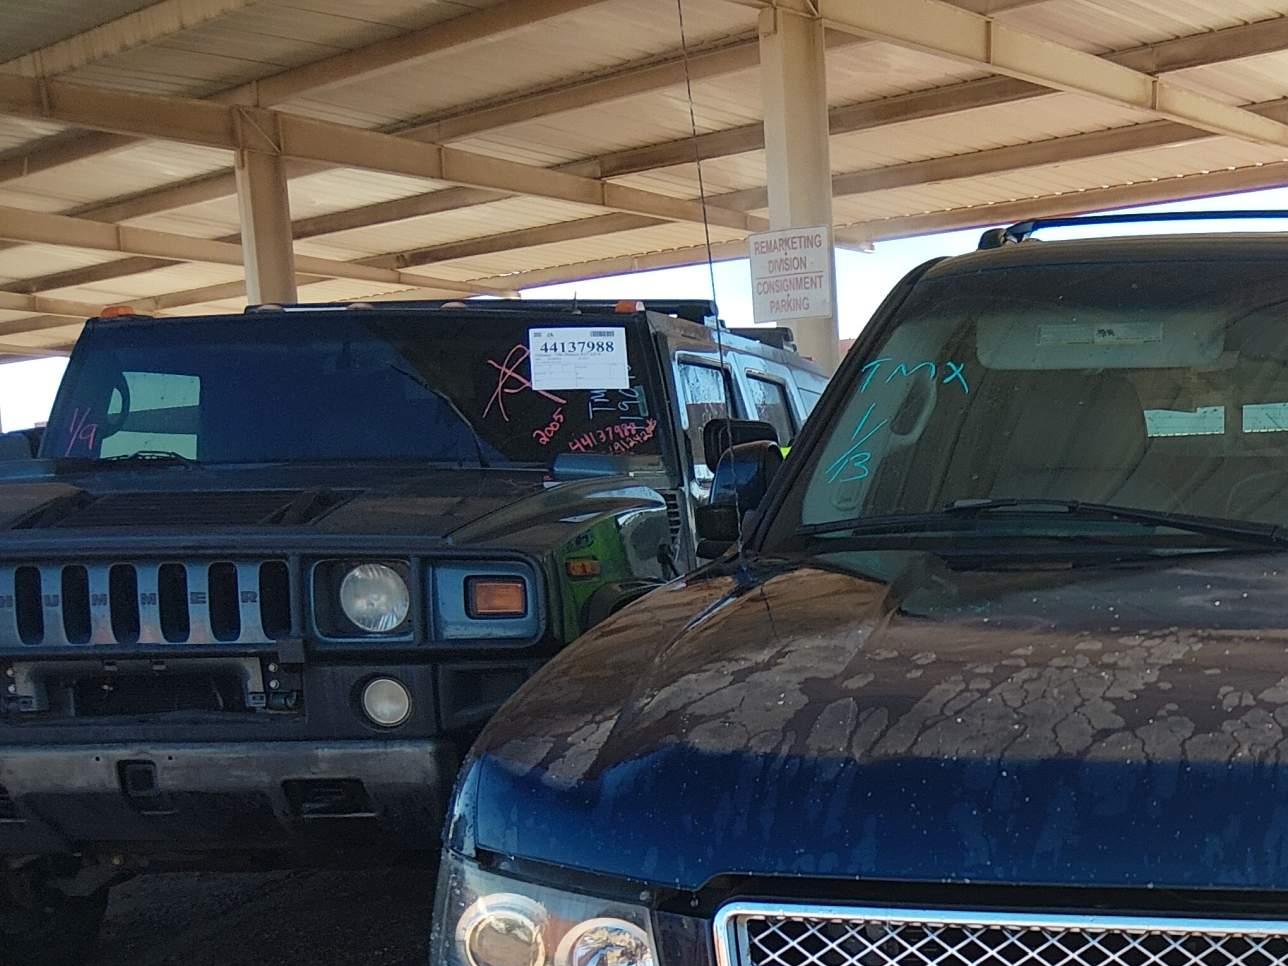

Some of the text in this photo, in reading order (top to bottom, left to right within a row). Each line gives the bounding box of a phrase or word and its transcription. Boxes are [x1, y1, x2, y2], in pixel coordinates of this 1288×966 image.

[754, 234, 822, 256] REMARKETING
[768, 256, 807, 274] DIVISION
[756, 275, 824, 296] CONSIGNMENT
[769, 296, 810, 313] PARKING
[540, 341, 615, 353] 44137988
[532, 407, 565, 445] 2005
